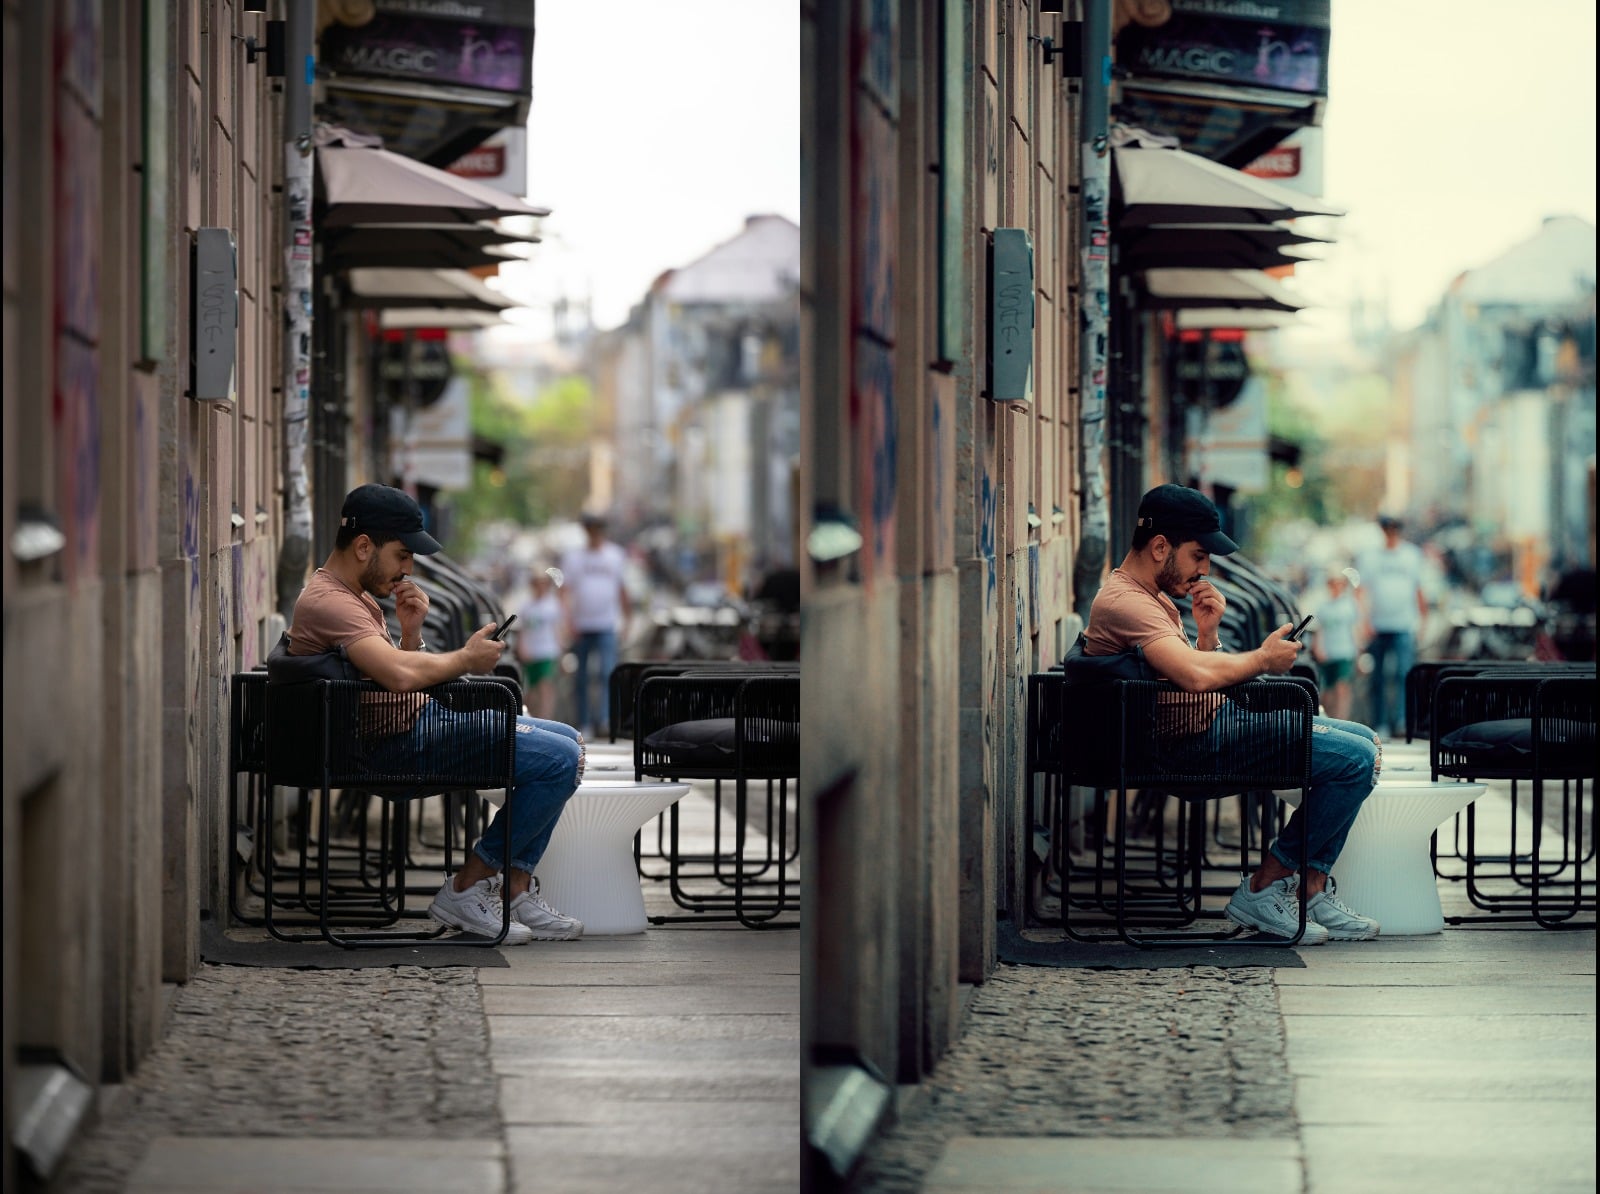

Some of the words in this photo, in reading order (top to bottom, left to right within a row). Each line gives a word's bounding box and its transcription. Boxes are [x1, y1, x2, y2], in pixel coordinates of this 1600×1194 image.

[343, 46, 438, 73] MAGIC
[1139, 47, 1235, 74] MAGIC
[1273, 903, 1284, 914] FILA
